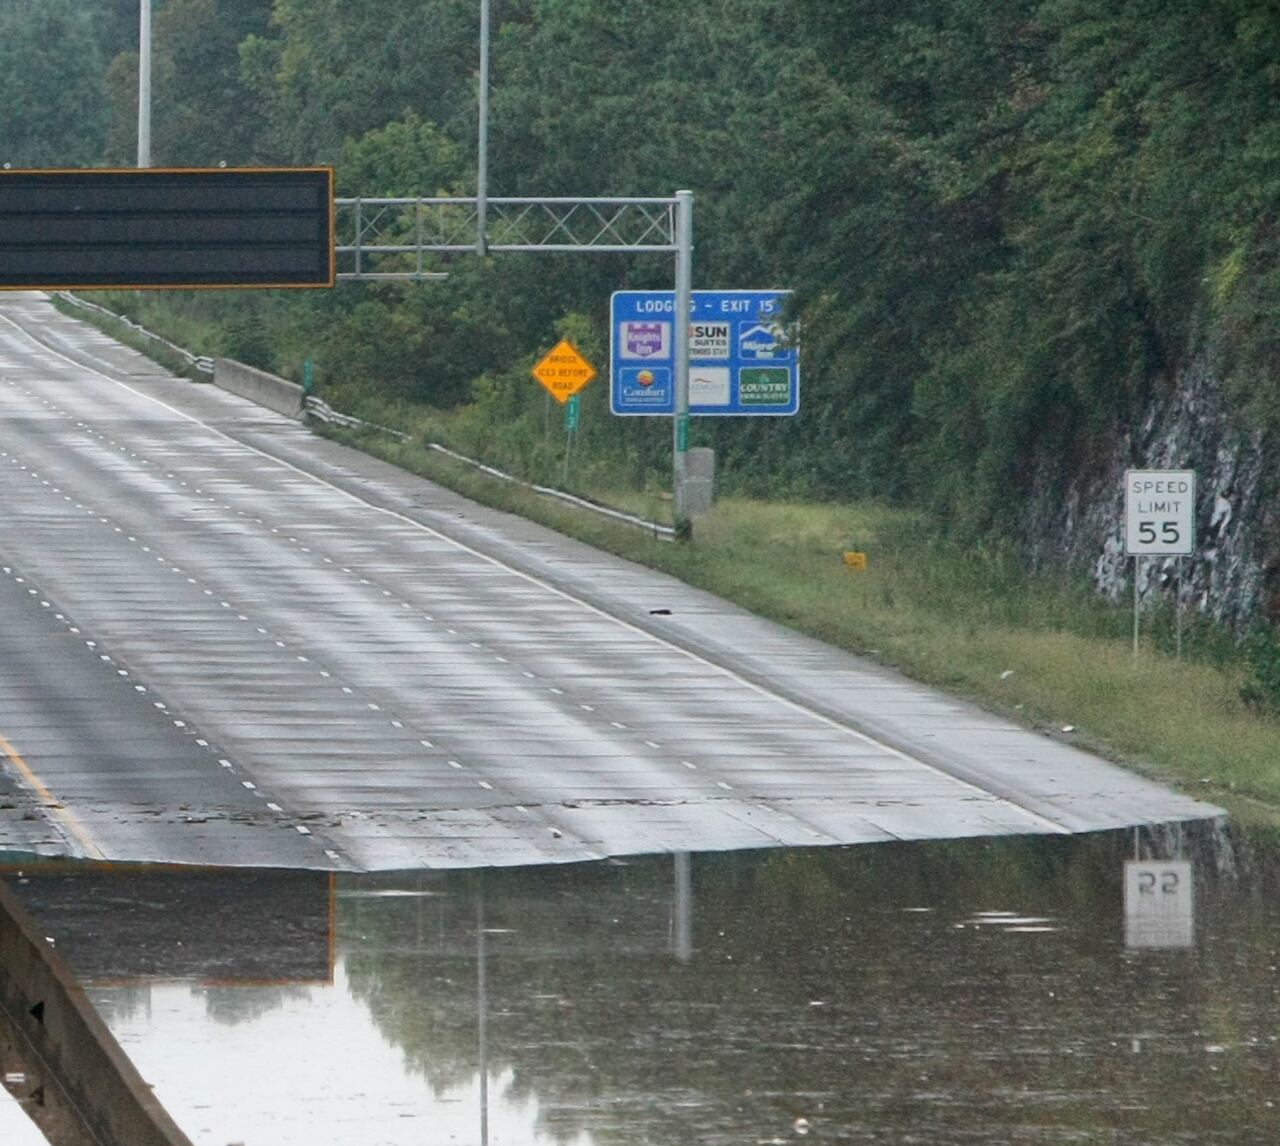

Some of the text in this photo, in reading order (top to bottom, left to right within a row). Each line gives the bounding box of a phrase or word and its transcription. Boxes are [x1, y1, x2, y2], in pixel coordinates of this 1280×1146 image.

[721, 300, 751, 311] EXIT
[759, 300, 774, 312] 15
[695, 327, 727, 338] SUN
[637, 343, 653, 354] Inn
[549, 355, 577, 363] BRIDGE
[558, 368, 588, 376] BEFORE
[623, 387, 665, 397] Comfort
[741, 384, 787, 392] COUNTRY
[1133, 482, 1188, 493] SPEED
[1138, 502, 1180, 513] LIMIT
[1139, 522, 1179, 544] 55
